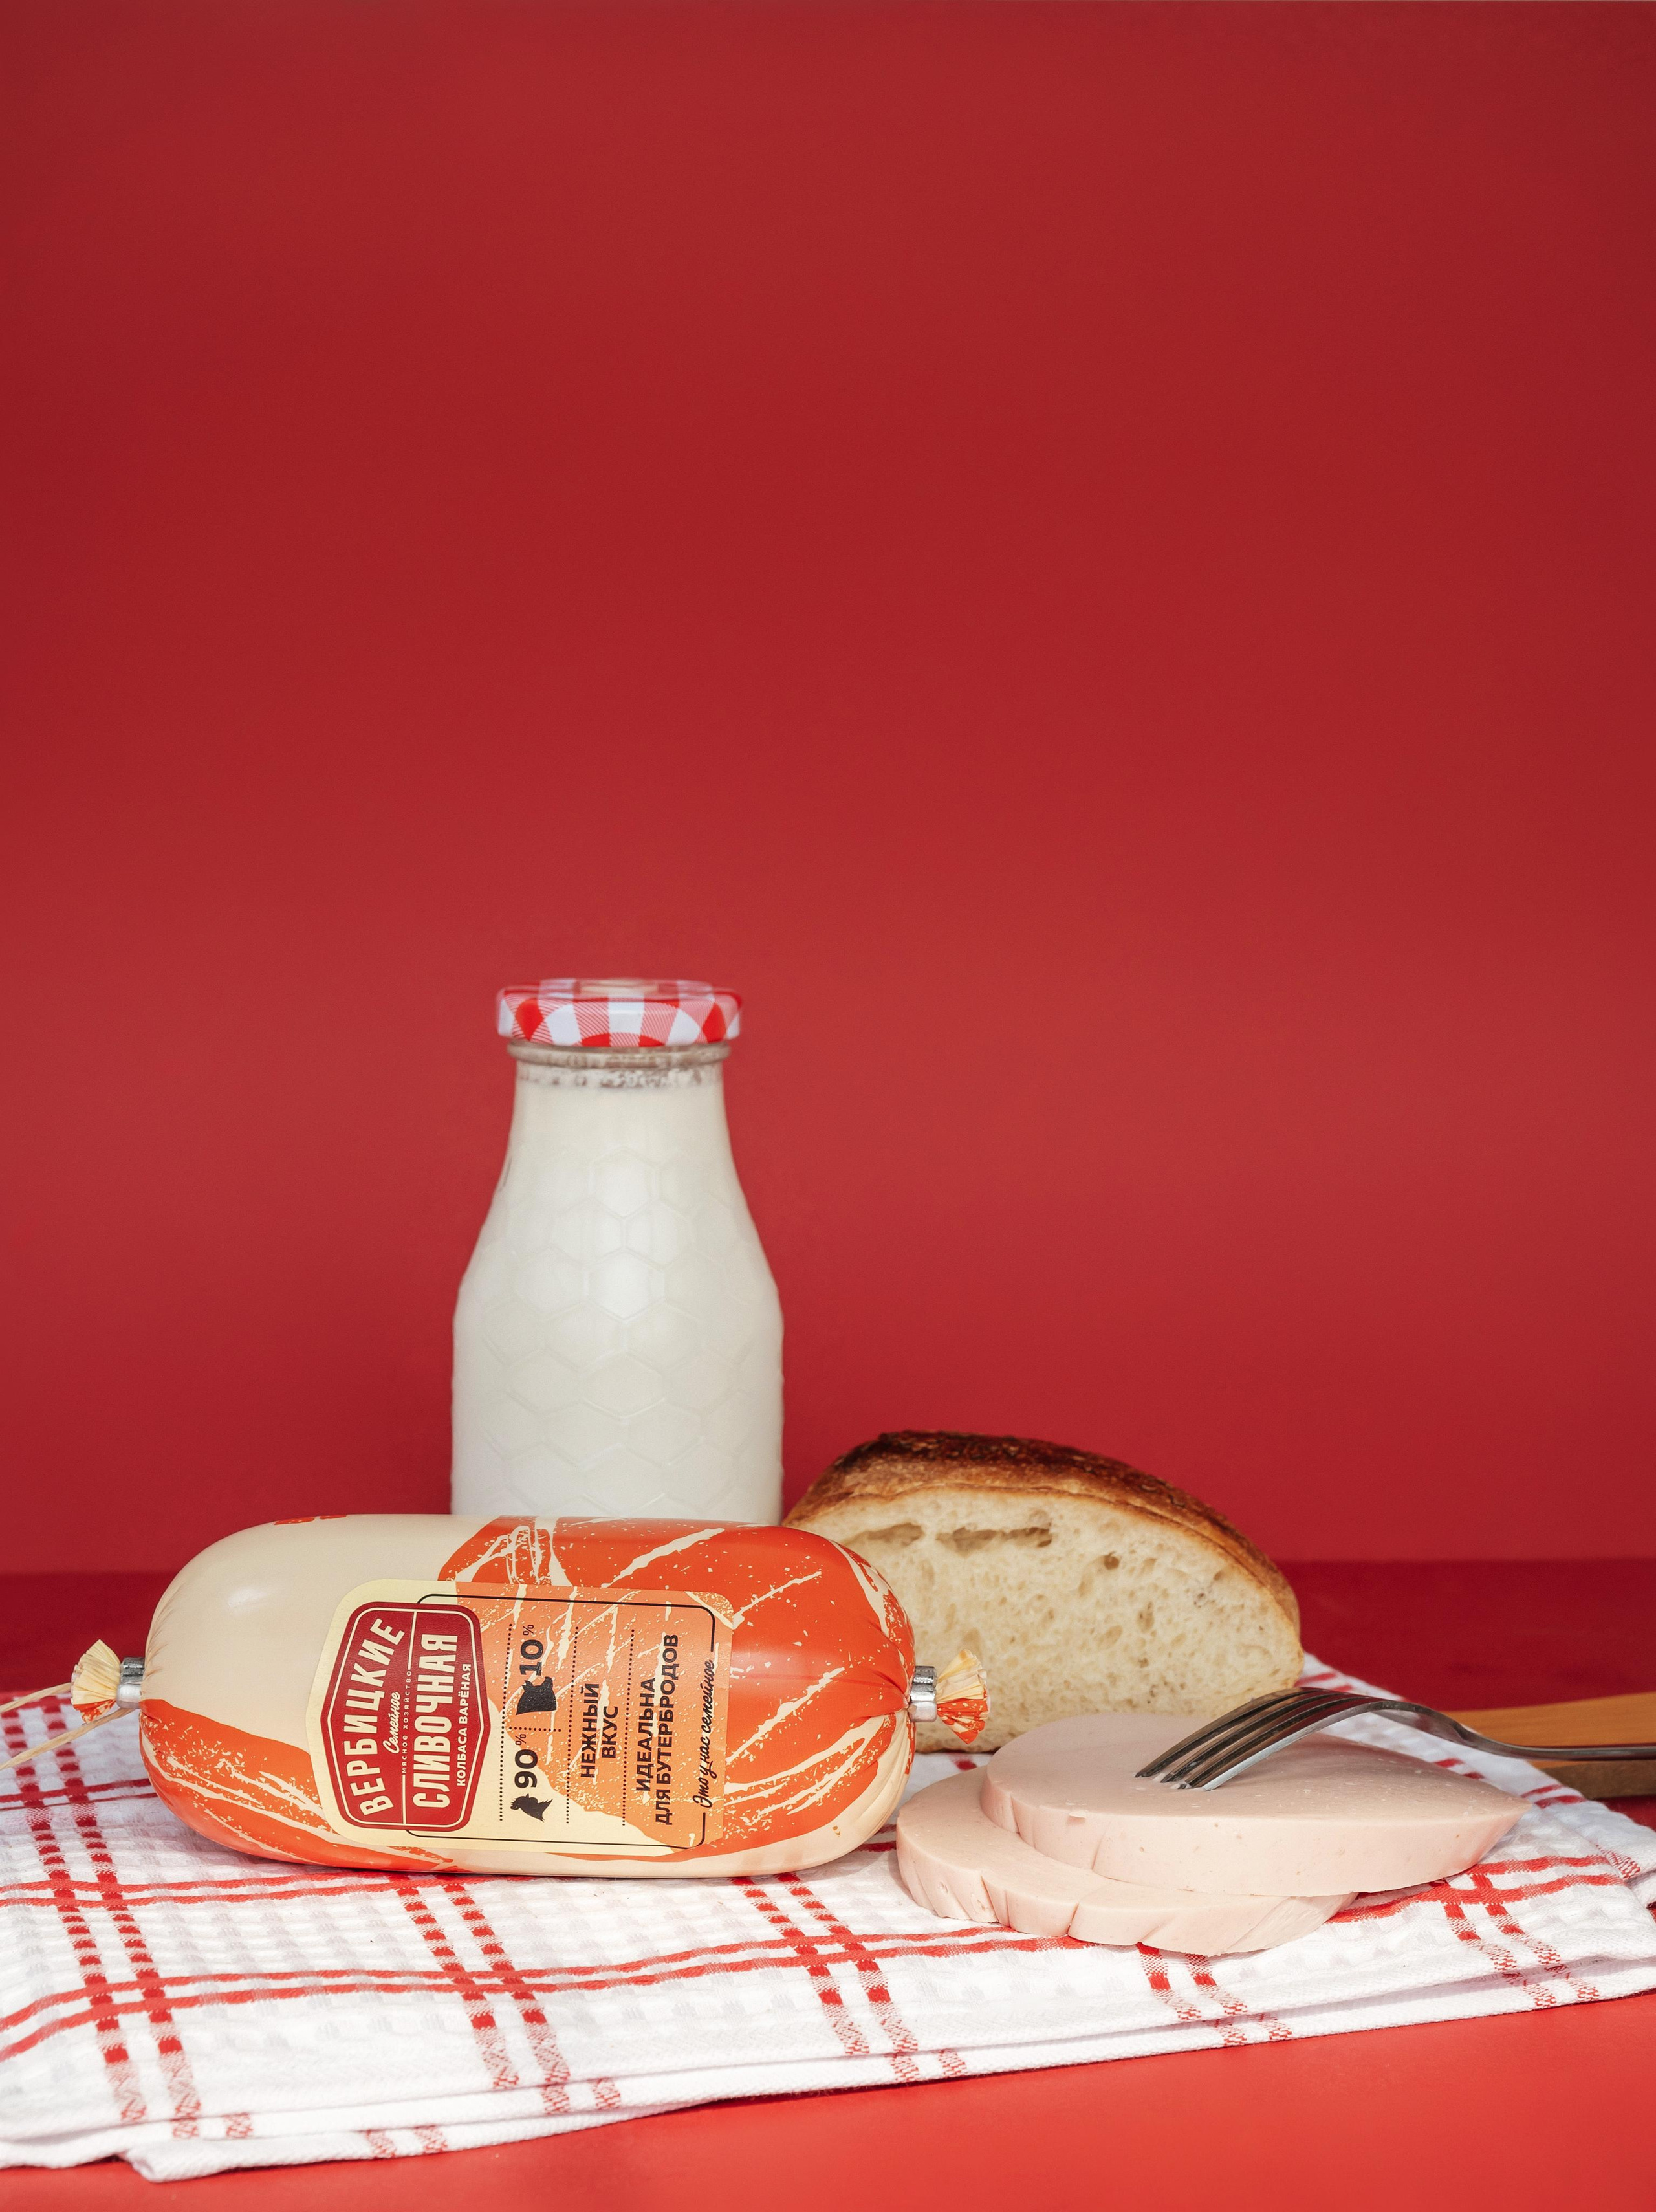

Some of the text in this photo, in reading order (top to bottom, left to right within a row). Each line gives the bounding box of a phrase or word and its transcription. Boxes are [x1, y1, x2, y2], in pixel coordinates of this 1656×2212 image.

[343, 1618, 405, 1815] ВЕРБИЦКИЕ
[383, 1691, 401, 1753] Семейное
[413, 1634, 458, 1808] СЛИВОЧНАЯ
[457, 1664, 472, 1786] КОЛБАСА ВАРЁНАЯ
[580, 1683, 600, 1778] НЕЖНЫЙ
[602, 1706, 618, 1758] ВКУС
[636, 1677, 656, 1791] ИДЕАЛЬНА
[655, 1634, 679, 1825] ДЛЯ БУТЕРБРОДОВ
[693, 1659, 717, 1808] Это у нас семейное
